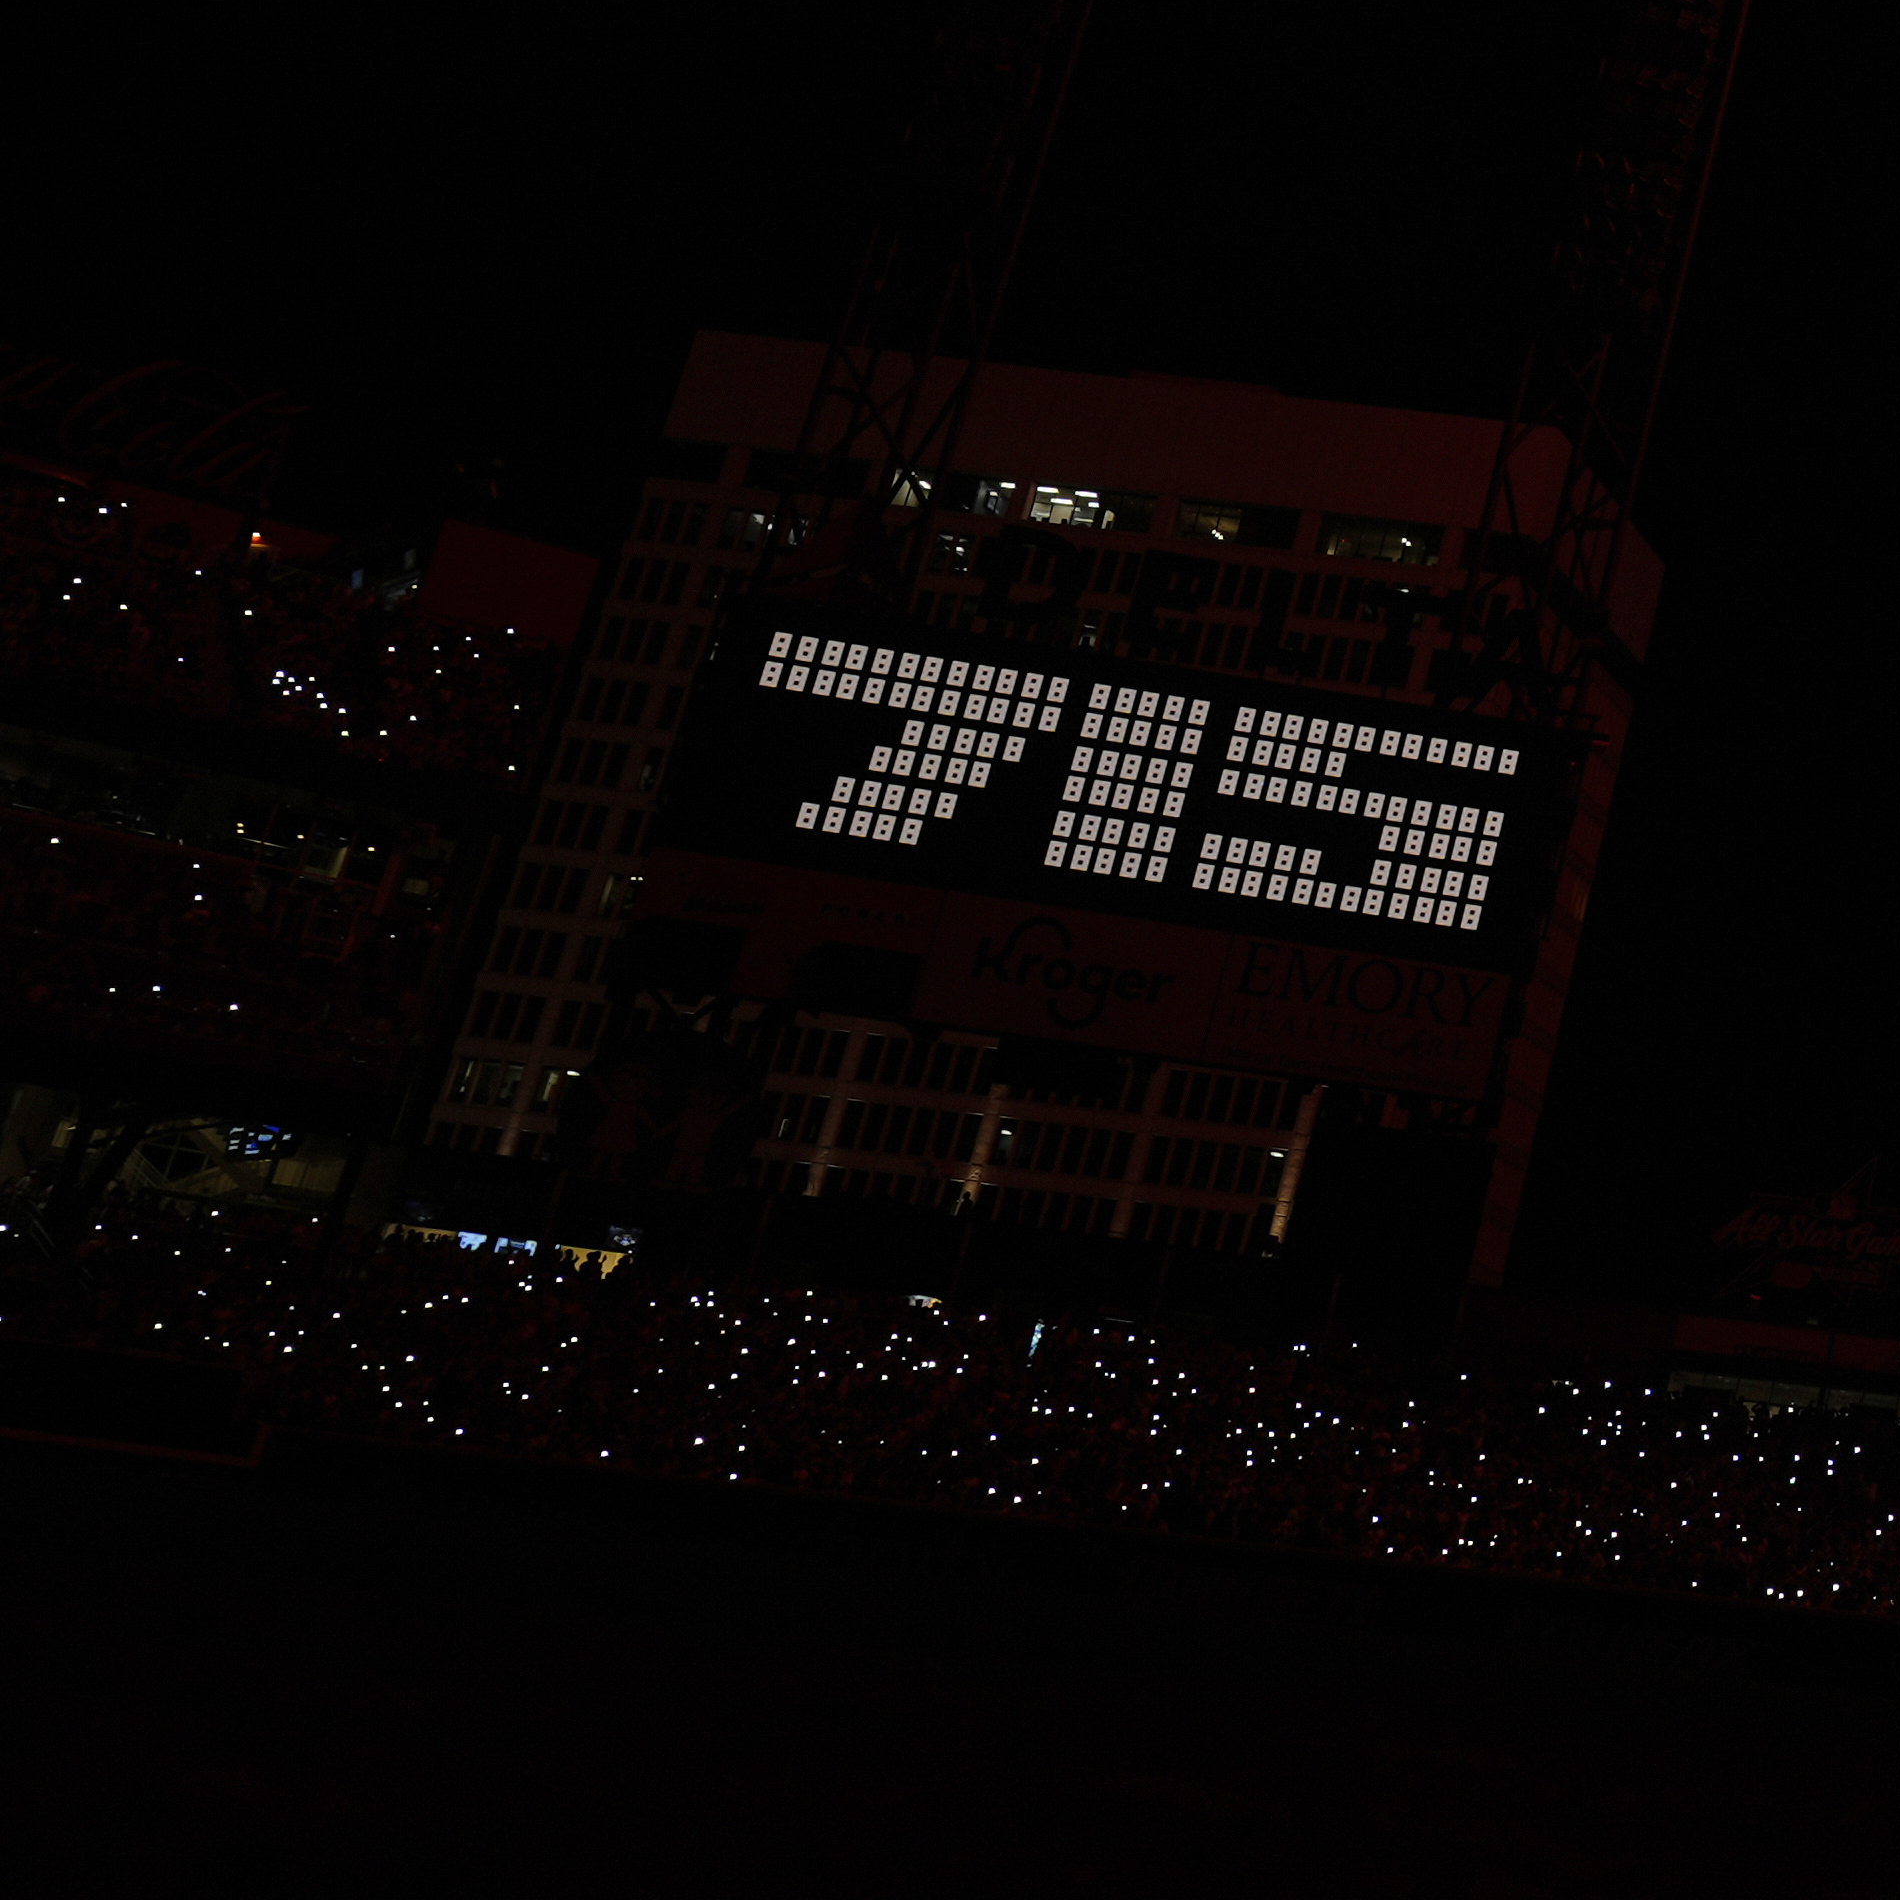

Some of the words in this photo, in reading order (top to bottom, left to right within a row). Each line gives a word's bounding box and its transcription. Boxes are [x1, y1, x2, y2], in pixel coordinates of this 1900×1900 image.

[757, 630, 1522, 933] 715
[970, 916, 1174, 1029] Kroger
[1235, 941, 1496, 1028] EMORY
